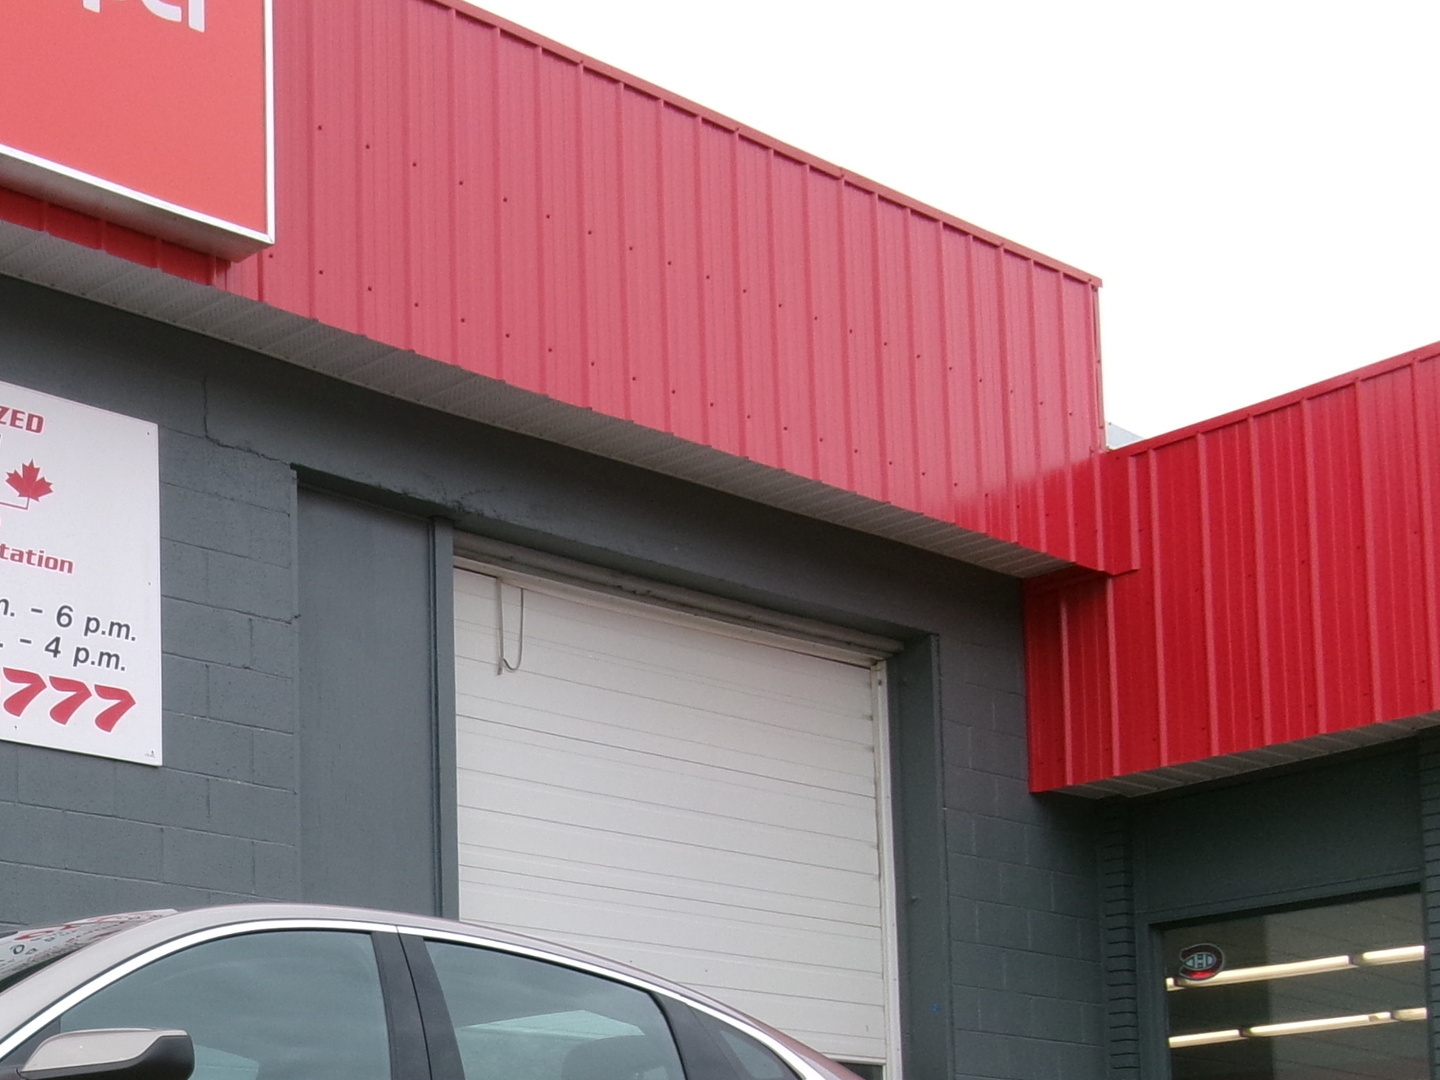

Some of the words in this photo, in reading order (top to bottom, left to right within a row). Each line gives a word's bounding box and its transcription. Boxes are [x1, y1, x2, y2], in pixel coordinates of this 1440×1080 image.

[57, 606, 73, 627] 6
[84, 617, 137, 641] p.m.
[45, 637, 60, 657] 4
[73, 647, 126, 672] p.m.
